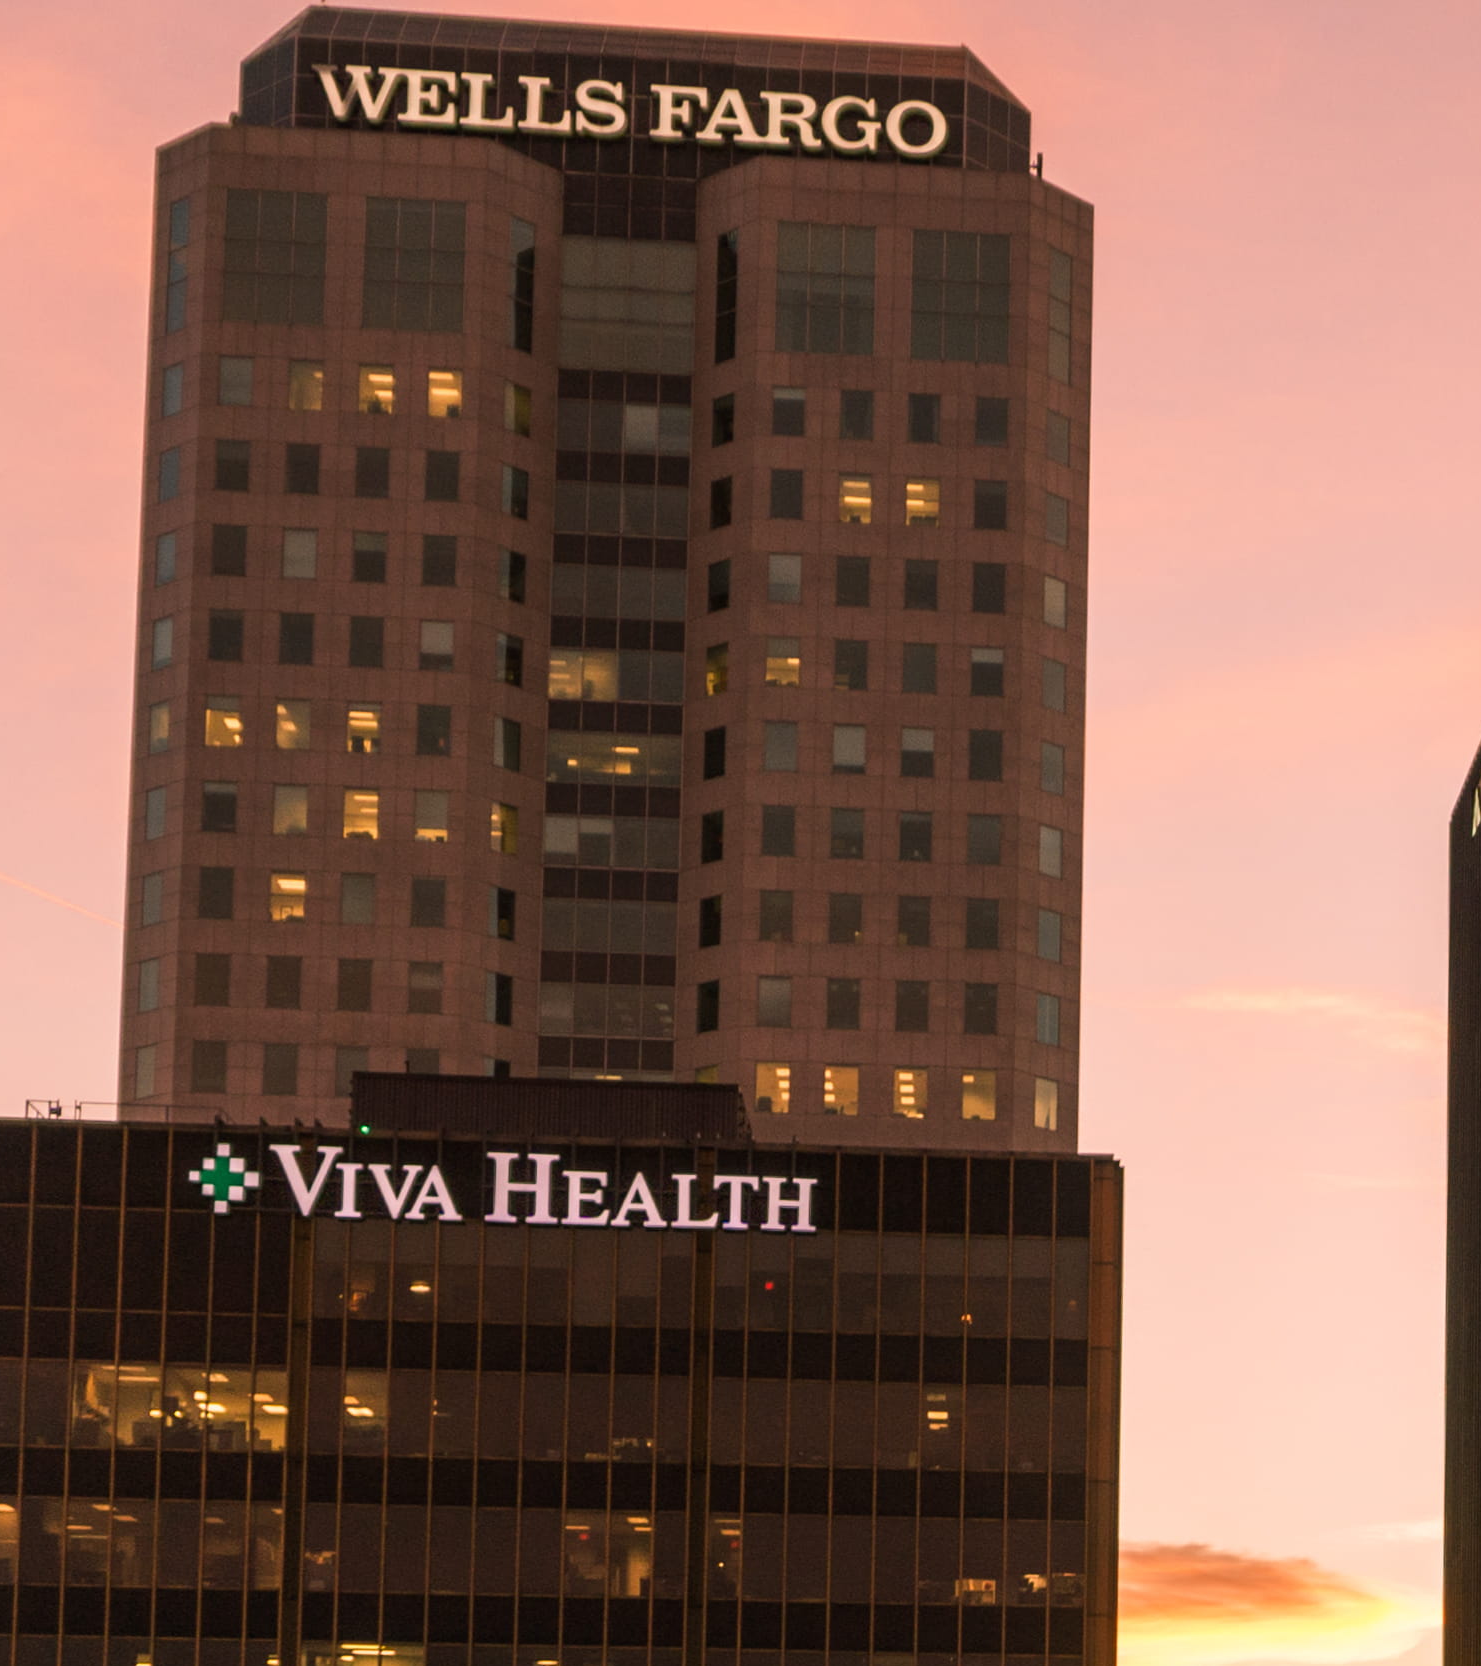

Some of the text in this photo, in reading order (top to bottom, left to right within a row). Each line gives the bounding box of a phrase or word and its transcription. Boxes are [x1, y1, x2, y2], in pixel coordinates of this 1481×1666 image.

[312, 62, 949, 161] WELLS FARGO
[269, 1143, 818, 1233] VIVA HEALTH
